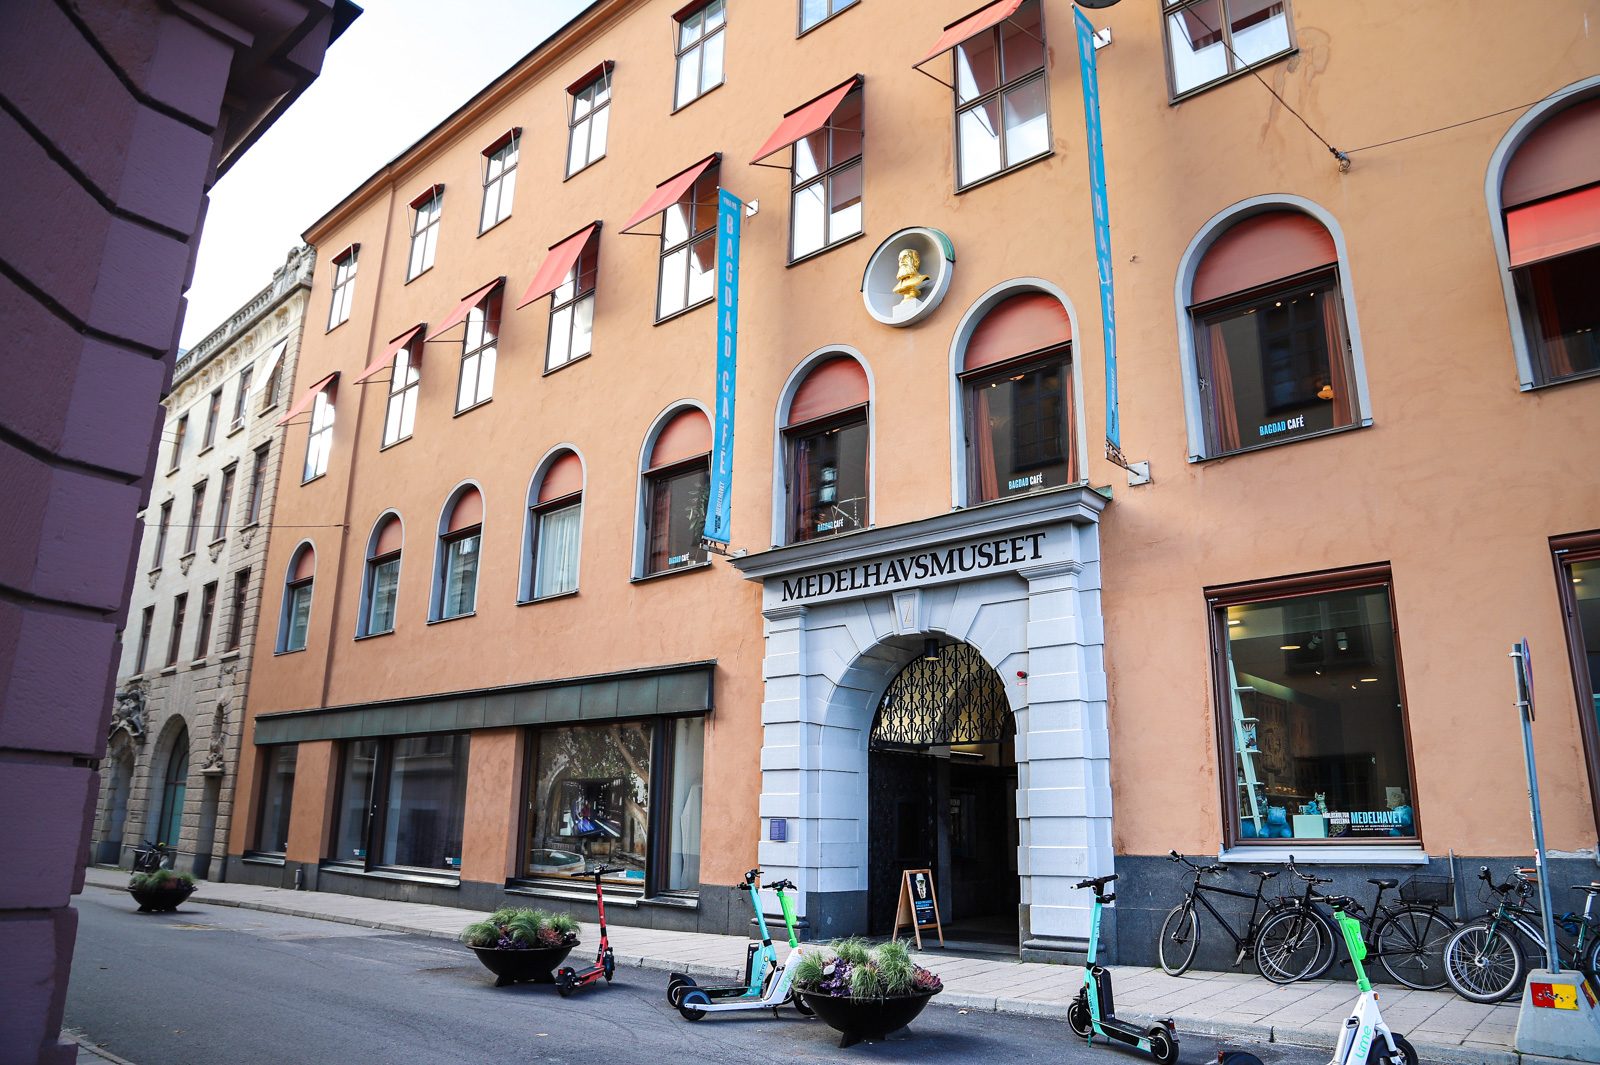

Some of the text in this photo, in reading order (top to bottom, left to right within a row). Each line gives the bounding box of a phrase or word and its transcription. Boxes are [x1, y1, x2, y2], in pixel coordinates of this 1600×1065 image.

[724, 213, 734, 358] BAGDAD
[1259, 414, 1305, 436] BAGDAD CAFÉ
[1008, 472, 1043, 490] BAGDAD CAFÉ
[781, 532, 1047, 602] MEDELHAVSMUSEET
[1350, 811, 1402, 824] MEDELHAVET
[1355, 1025, 1372, 1059] Lime
